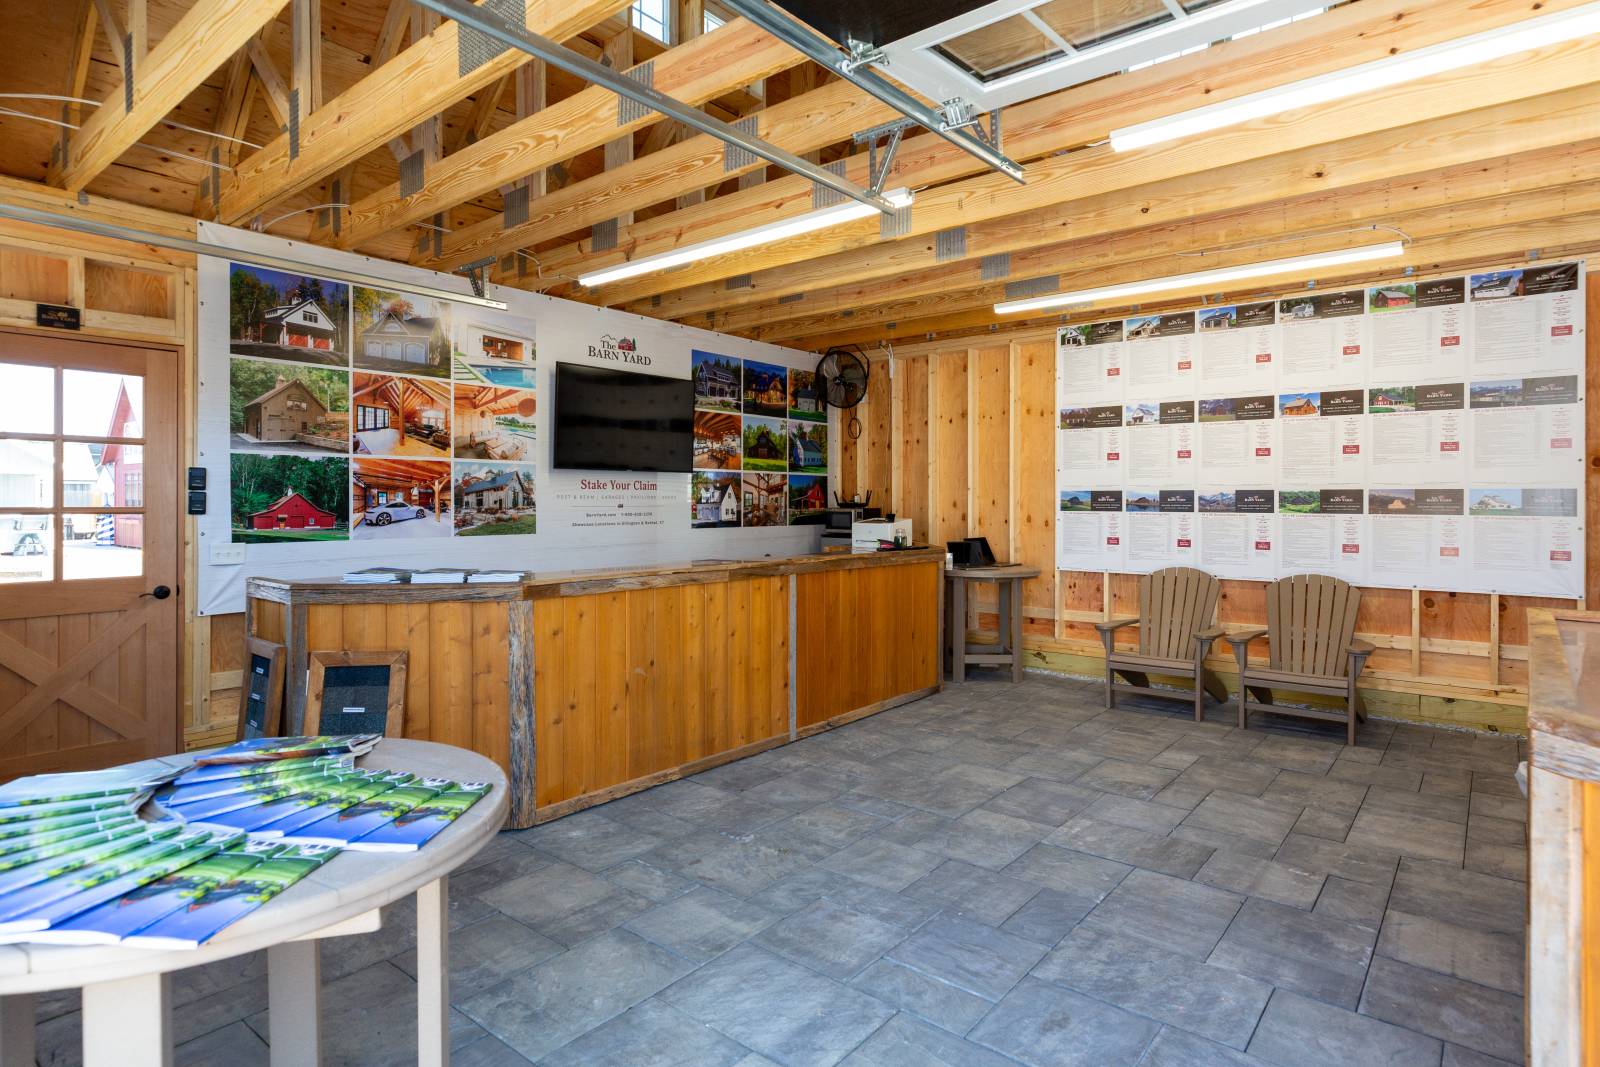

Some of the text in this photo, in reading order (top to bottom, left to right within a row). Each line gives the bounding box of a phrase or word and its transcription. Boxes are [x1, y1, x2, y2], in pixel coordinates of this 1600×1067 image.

[600, 340, 616, 350] The
[588, 346, 652, 366] BARN YARD
[580, 479, 657, 491] Stake Your Claim
